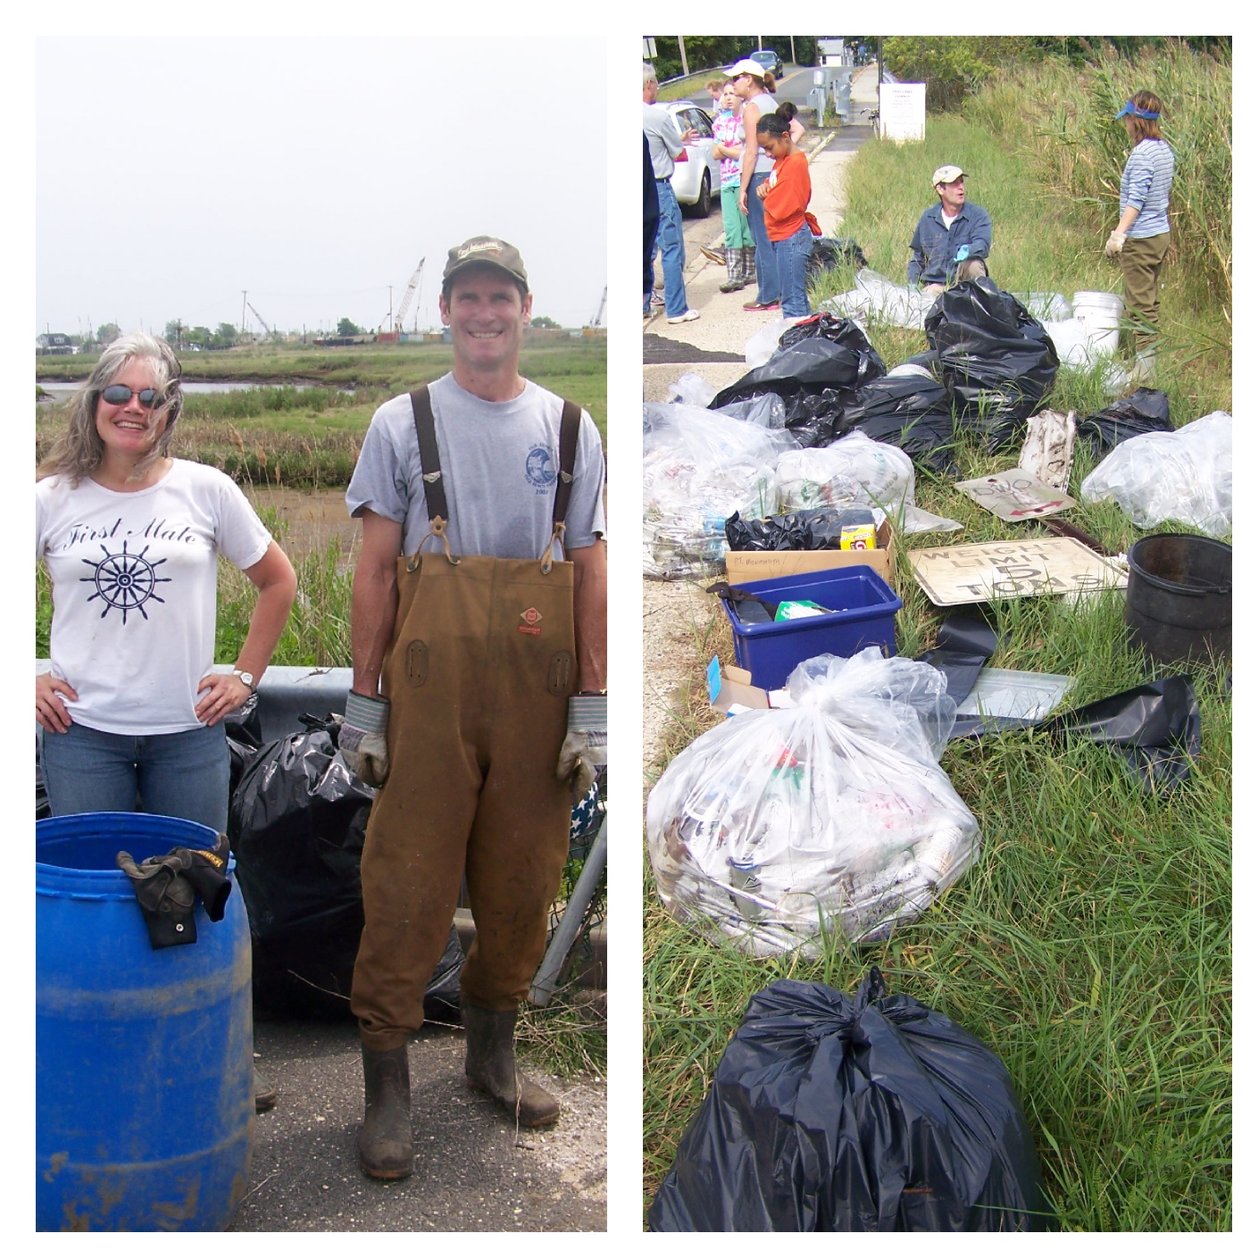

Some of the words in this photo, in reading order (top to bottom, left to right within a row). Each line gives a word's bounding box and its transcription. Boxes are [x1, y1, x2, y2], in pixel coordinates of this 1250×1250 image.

[62, 517, 124, 551] First
[128, 517, 197, 546] Mate
[922, 541, 1062, 561] WEIGHT
[951, 553, 1051, 569] LIMIT
[995, 564, 1042, 580] 5
[956, 574, 1104, 597] TONS
